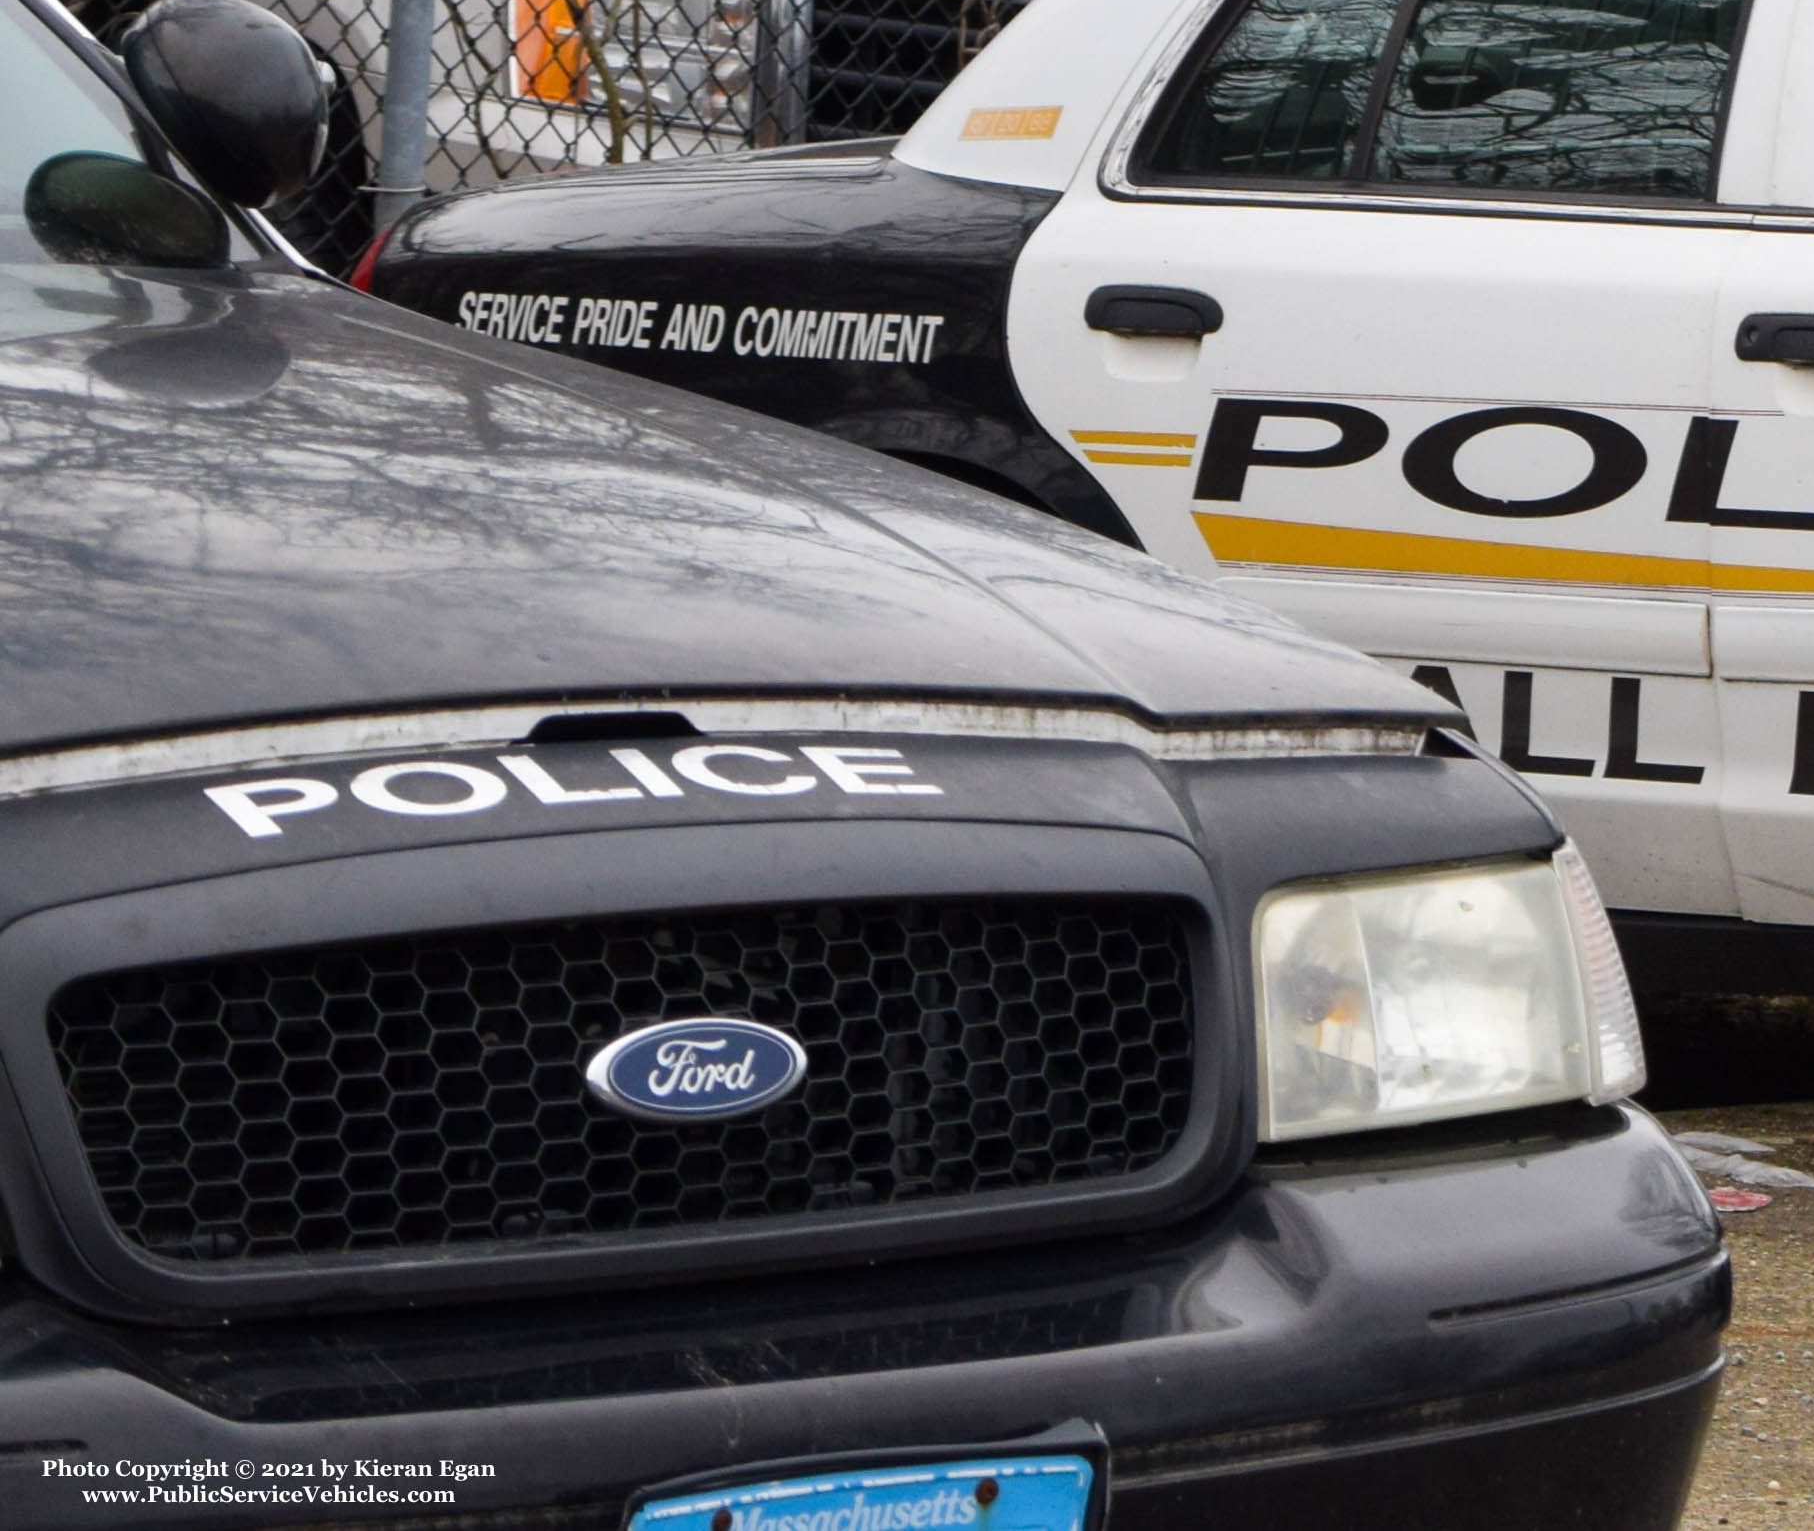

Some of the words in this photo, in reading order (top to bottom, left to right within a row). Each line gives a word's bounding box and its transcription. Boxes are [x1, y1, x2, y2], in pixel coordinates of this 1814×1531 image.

[455, 291, 569, 343] SERVICE
[572, 298, 658, 349] PRIDE
[661, 303, 724, 353] AND
[733, 307, 943, 364] COMMITMENT
[1410, 665, 1705, 785] LL
[204, 744, 944, 839] POLICE
[647, 1038, 755, 1095] Ford
